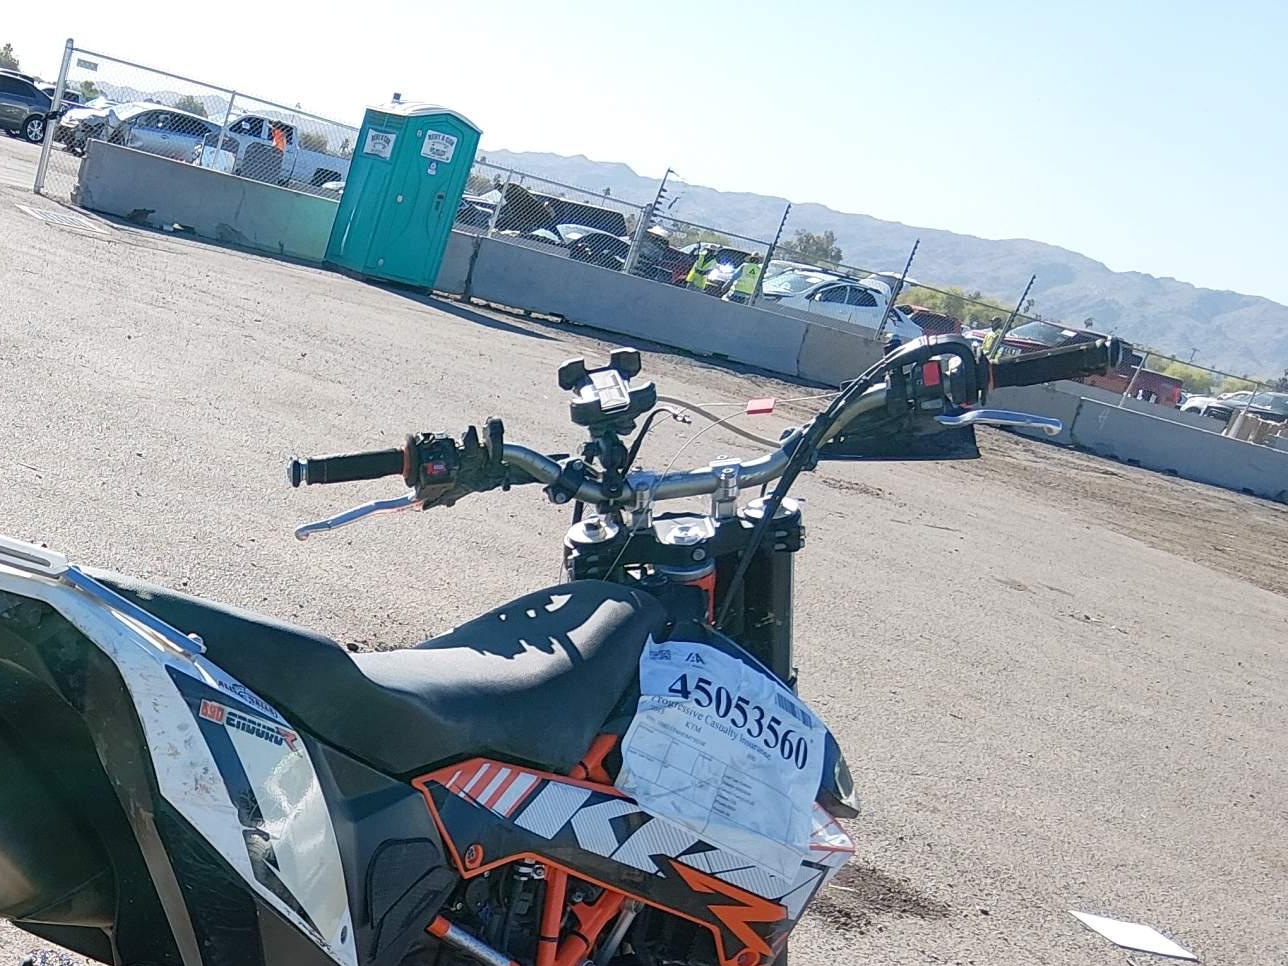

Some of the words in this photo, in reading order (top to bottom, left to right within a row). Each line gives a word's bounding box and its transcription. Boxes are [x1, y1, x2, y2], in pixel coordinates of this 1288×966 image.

[225, 711, 284, 746] ENDURO
[668, 673, 808, 770] 45053560
[685, 721, 703, 733] KTM
[705, 714, 738, 741] Casualty
